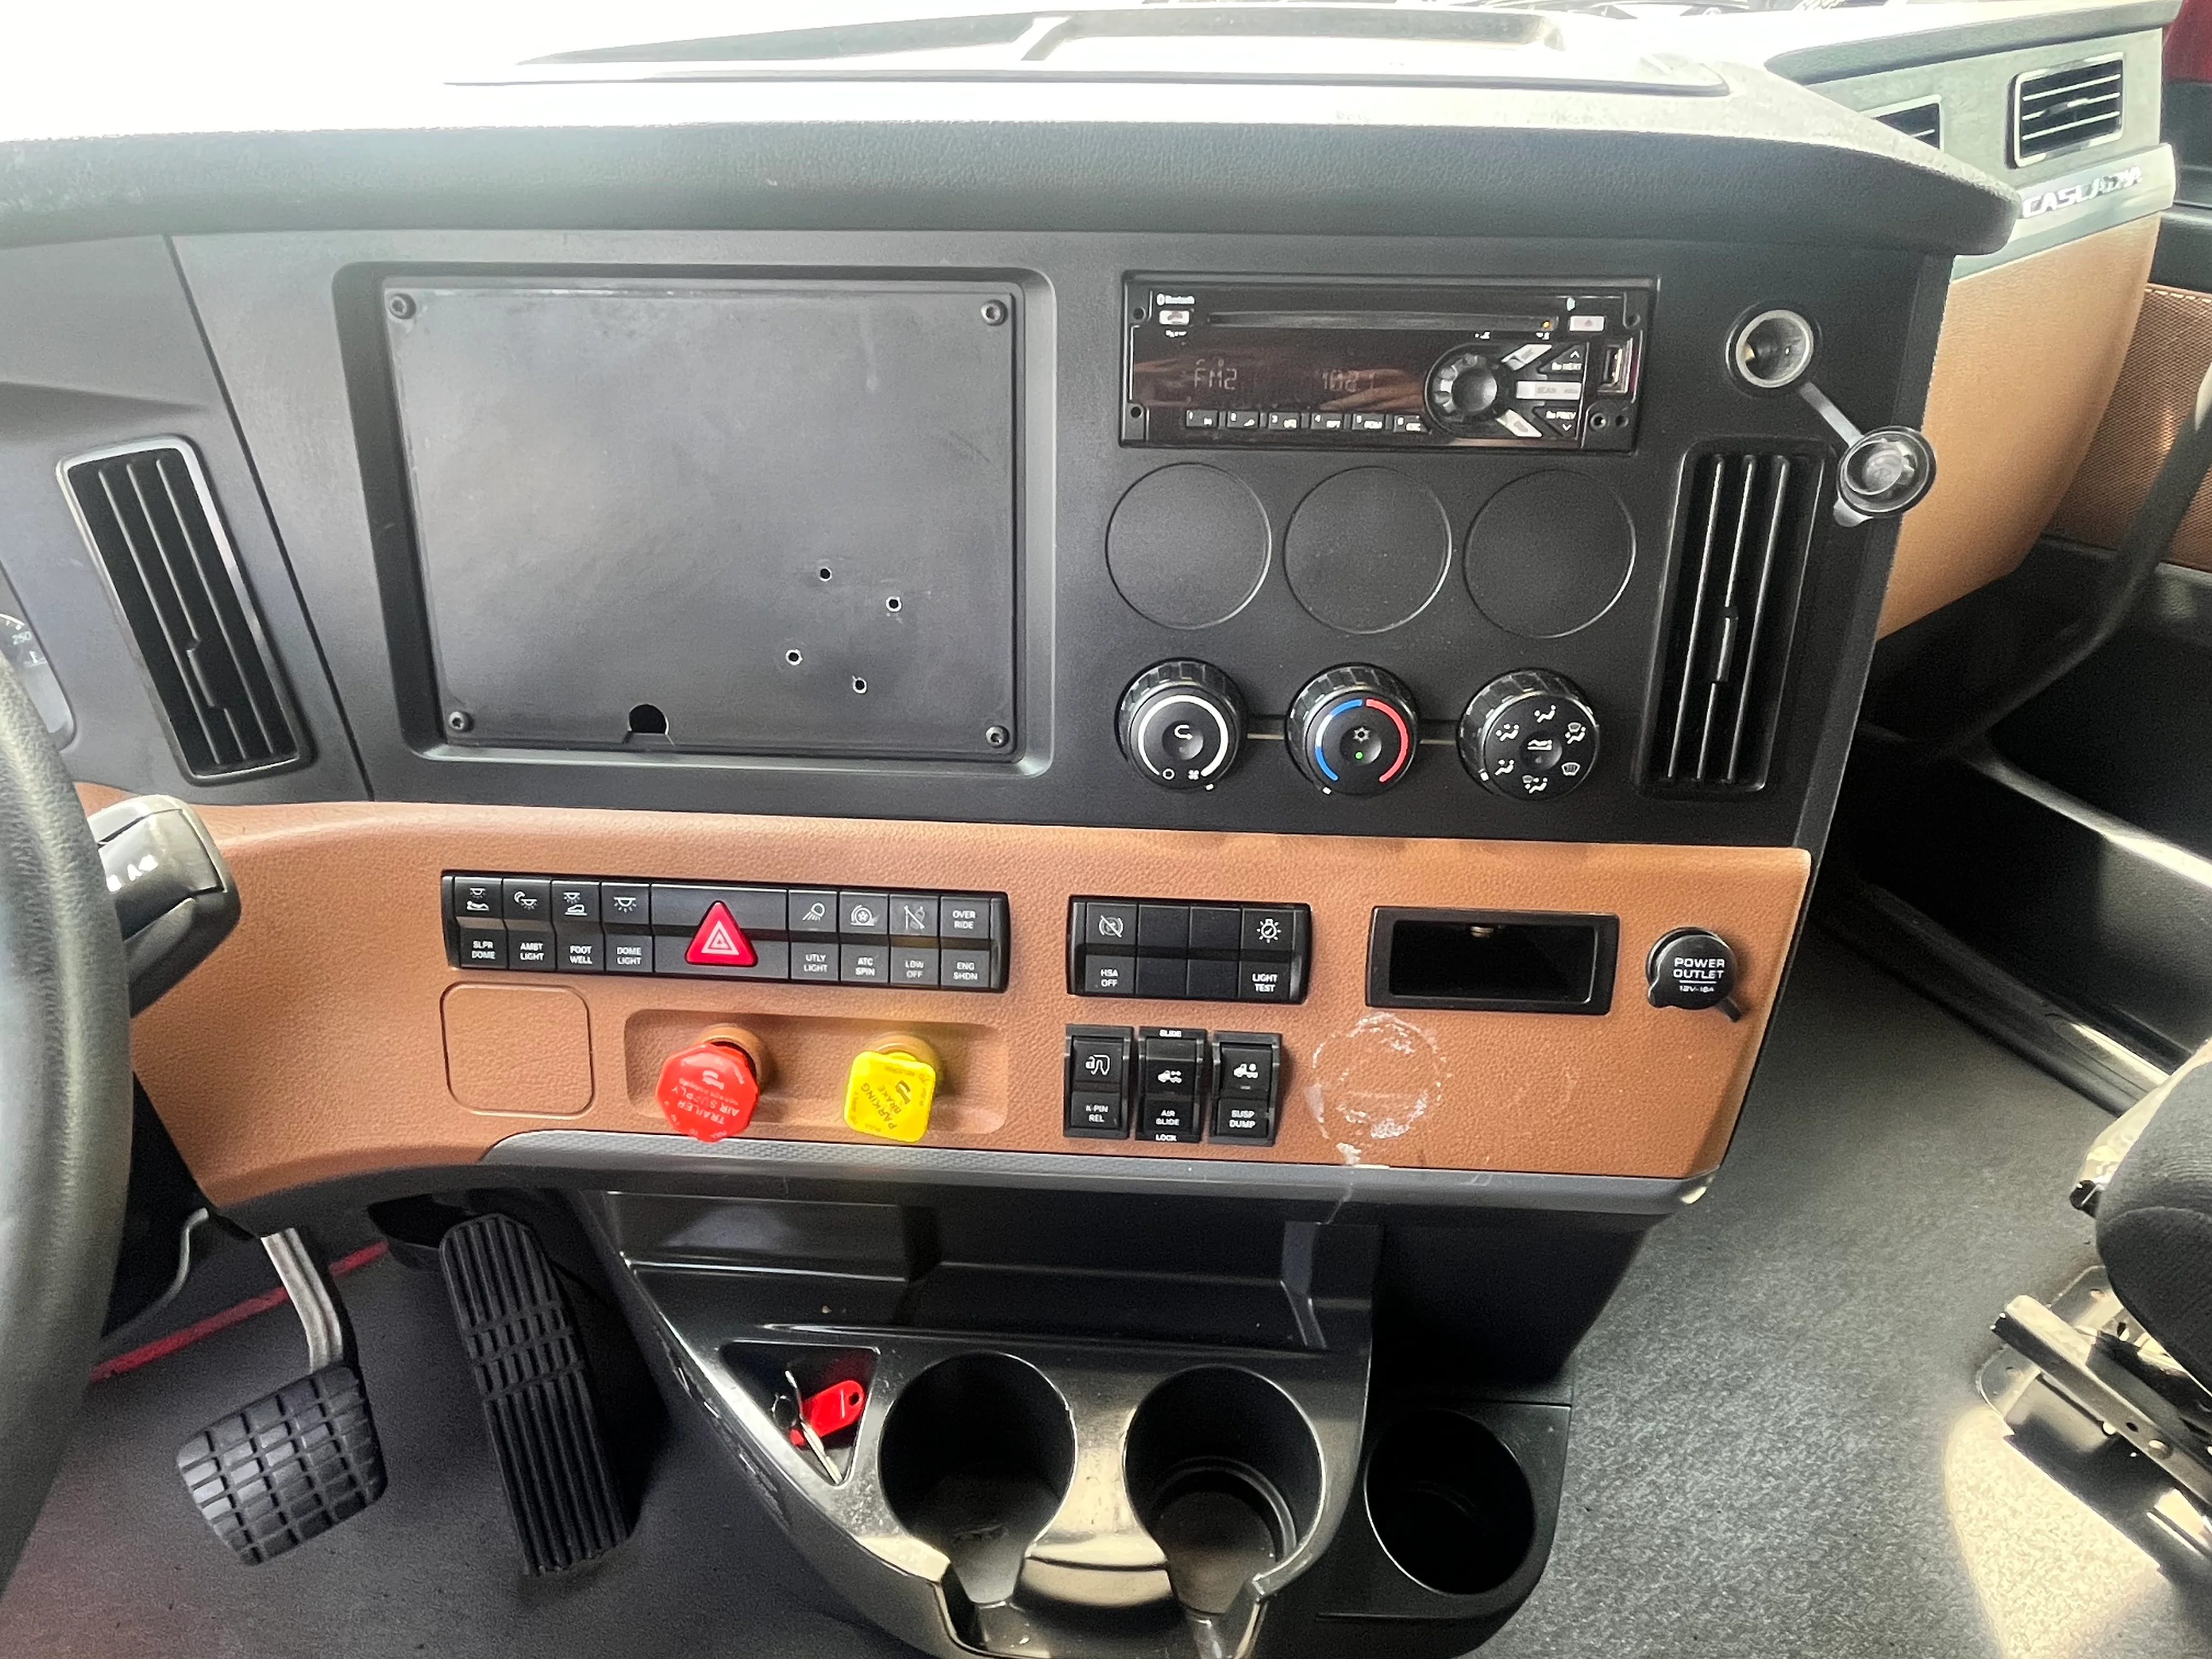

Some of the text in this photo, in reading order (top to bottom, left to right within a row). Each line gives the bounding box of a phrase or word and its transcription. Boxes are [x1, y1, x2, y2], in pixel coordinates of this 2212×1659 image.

[1194, 368, 1237, 391] FM2
[952, 910, 975, 919] OVER
[953, 921, 974, 929] RIDE
[473, 940, 494, 949] SLPR
[569, 945, 592, 954] FOOT
[617, 947, 642, 955] DOME
[472, 950, 496, 960] DOME
[520, 952, 544, 961] LIGHT
[569, 955, 592, 964] WELL
[805, 953, 826, 962] UTLY
[857, 956, 874, 966] ATC
[905, 960, 924, 968] LOW
[1674, 957, 1725, 968] POWER
[803, 963, 828, 972] LIGHT
[855, 967, 876, 976] SPIN
[906, 970, 923, 978] OFF
[953, 971, 978, 980] SHDN
[1252, 973, 1278, 983] LIGHT
[1673, 969, 1724, 979] OUTLET
[1101, 979, 1118, 988] OFF
[1254, 983, 1276, 992] TEST
[671, 1085, 718, 1110] SUPPLY
[877, 1084, 902, 1115] BRAKE
[719, 1102, 741, 1118] AIR
[860, 1082, 898, 1130] PARKING
[677, 1099, 725, 1125] TRAILER
[1231, 1109, 1255, 1118] SUSP
[1088, 1114, 1105, 1123] REL
[1229, 1119, 1256, 1128] DUMP
[1155, 1133, 1177, 1142] LOCK
